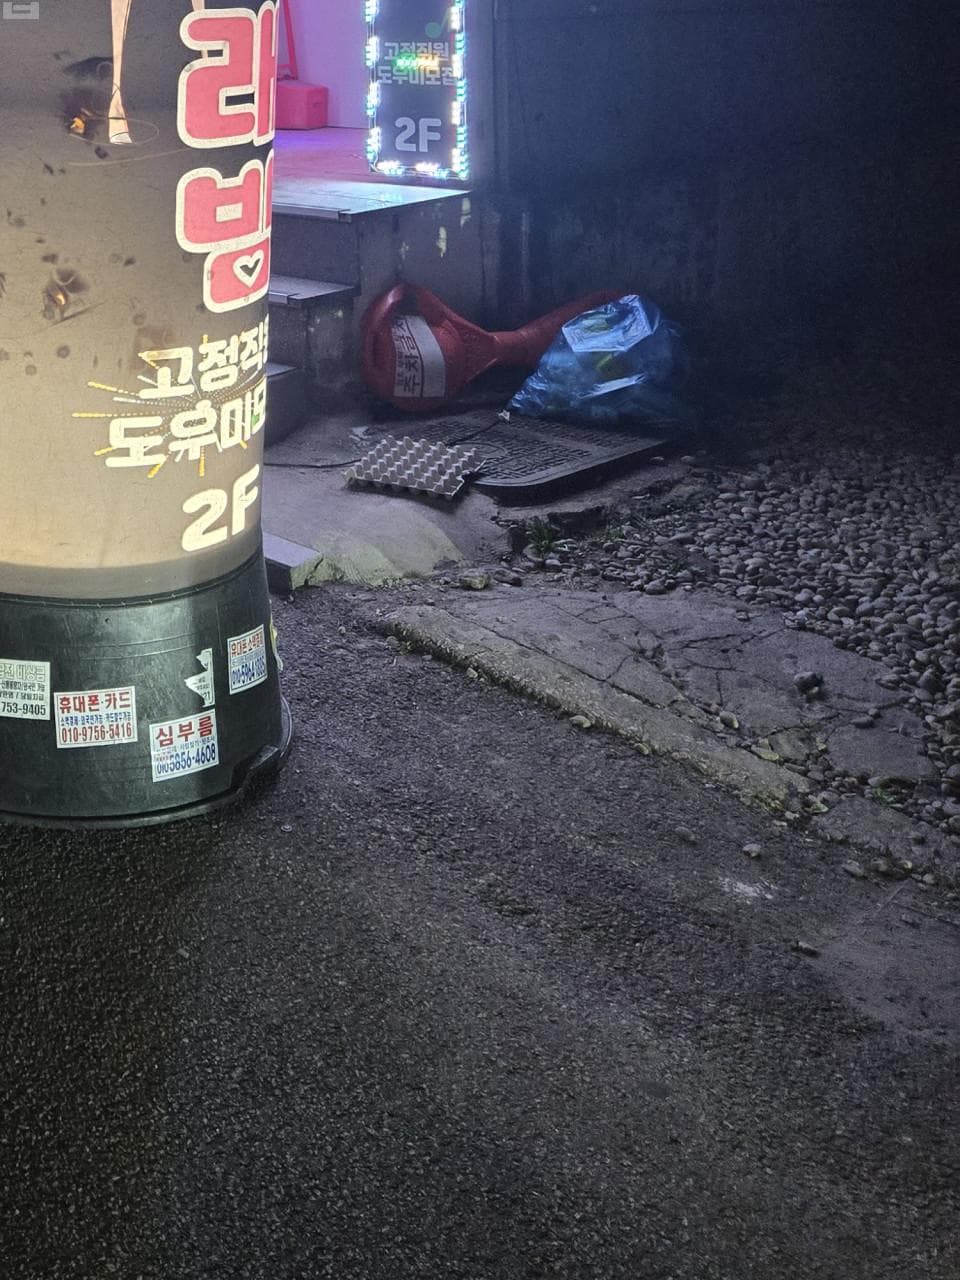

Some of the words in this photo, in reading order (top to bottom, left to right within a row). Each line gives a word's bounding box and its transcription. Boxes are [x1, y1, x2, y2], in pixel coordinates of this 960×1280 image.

[394, 117, 442, 153] 2F
[182, 463, 260, 552] 2F
[156, 715, 214, 748] 심부름
